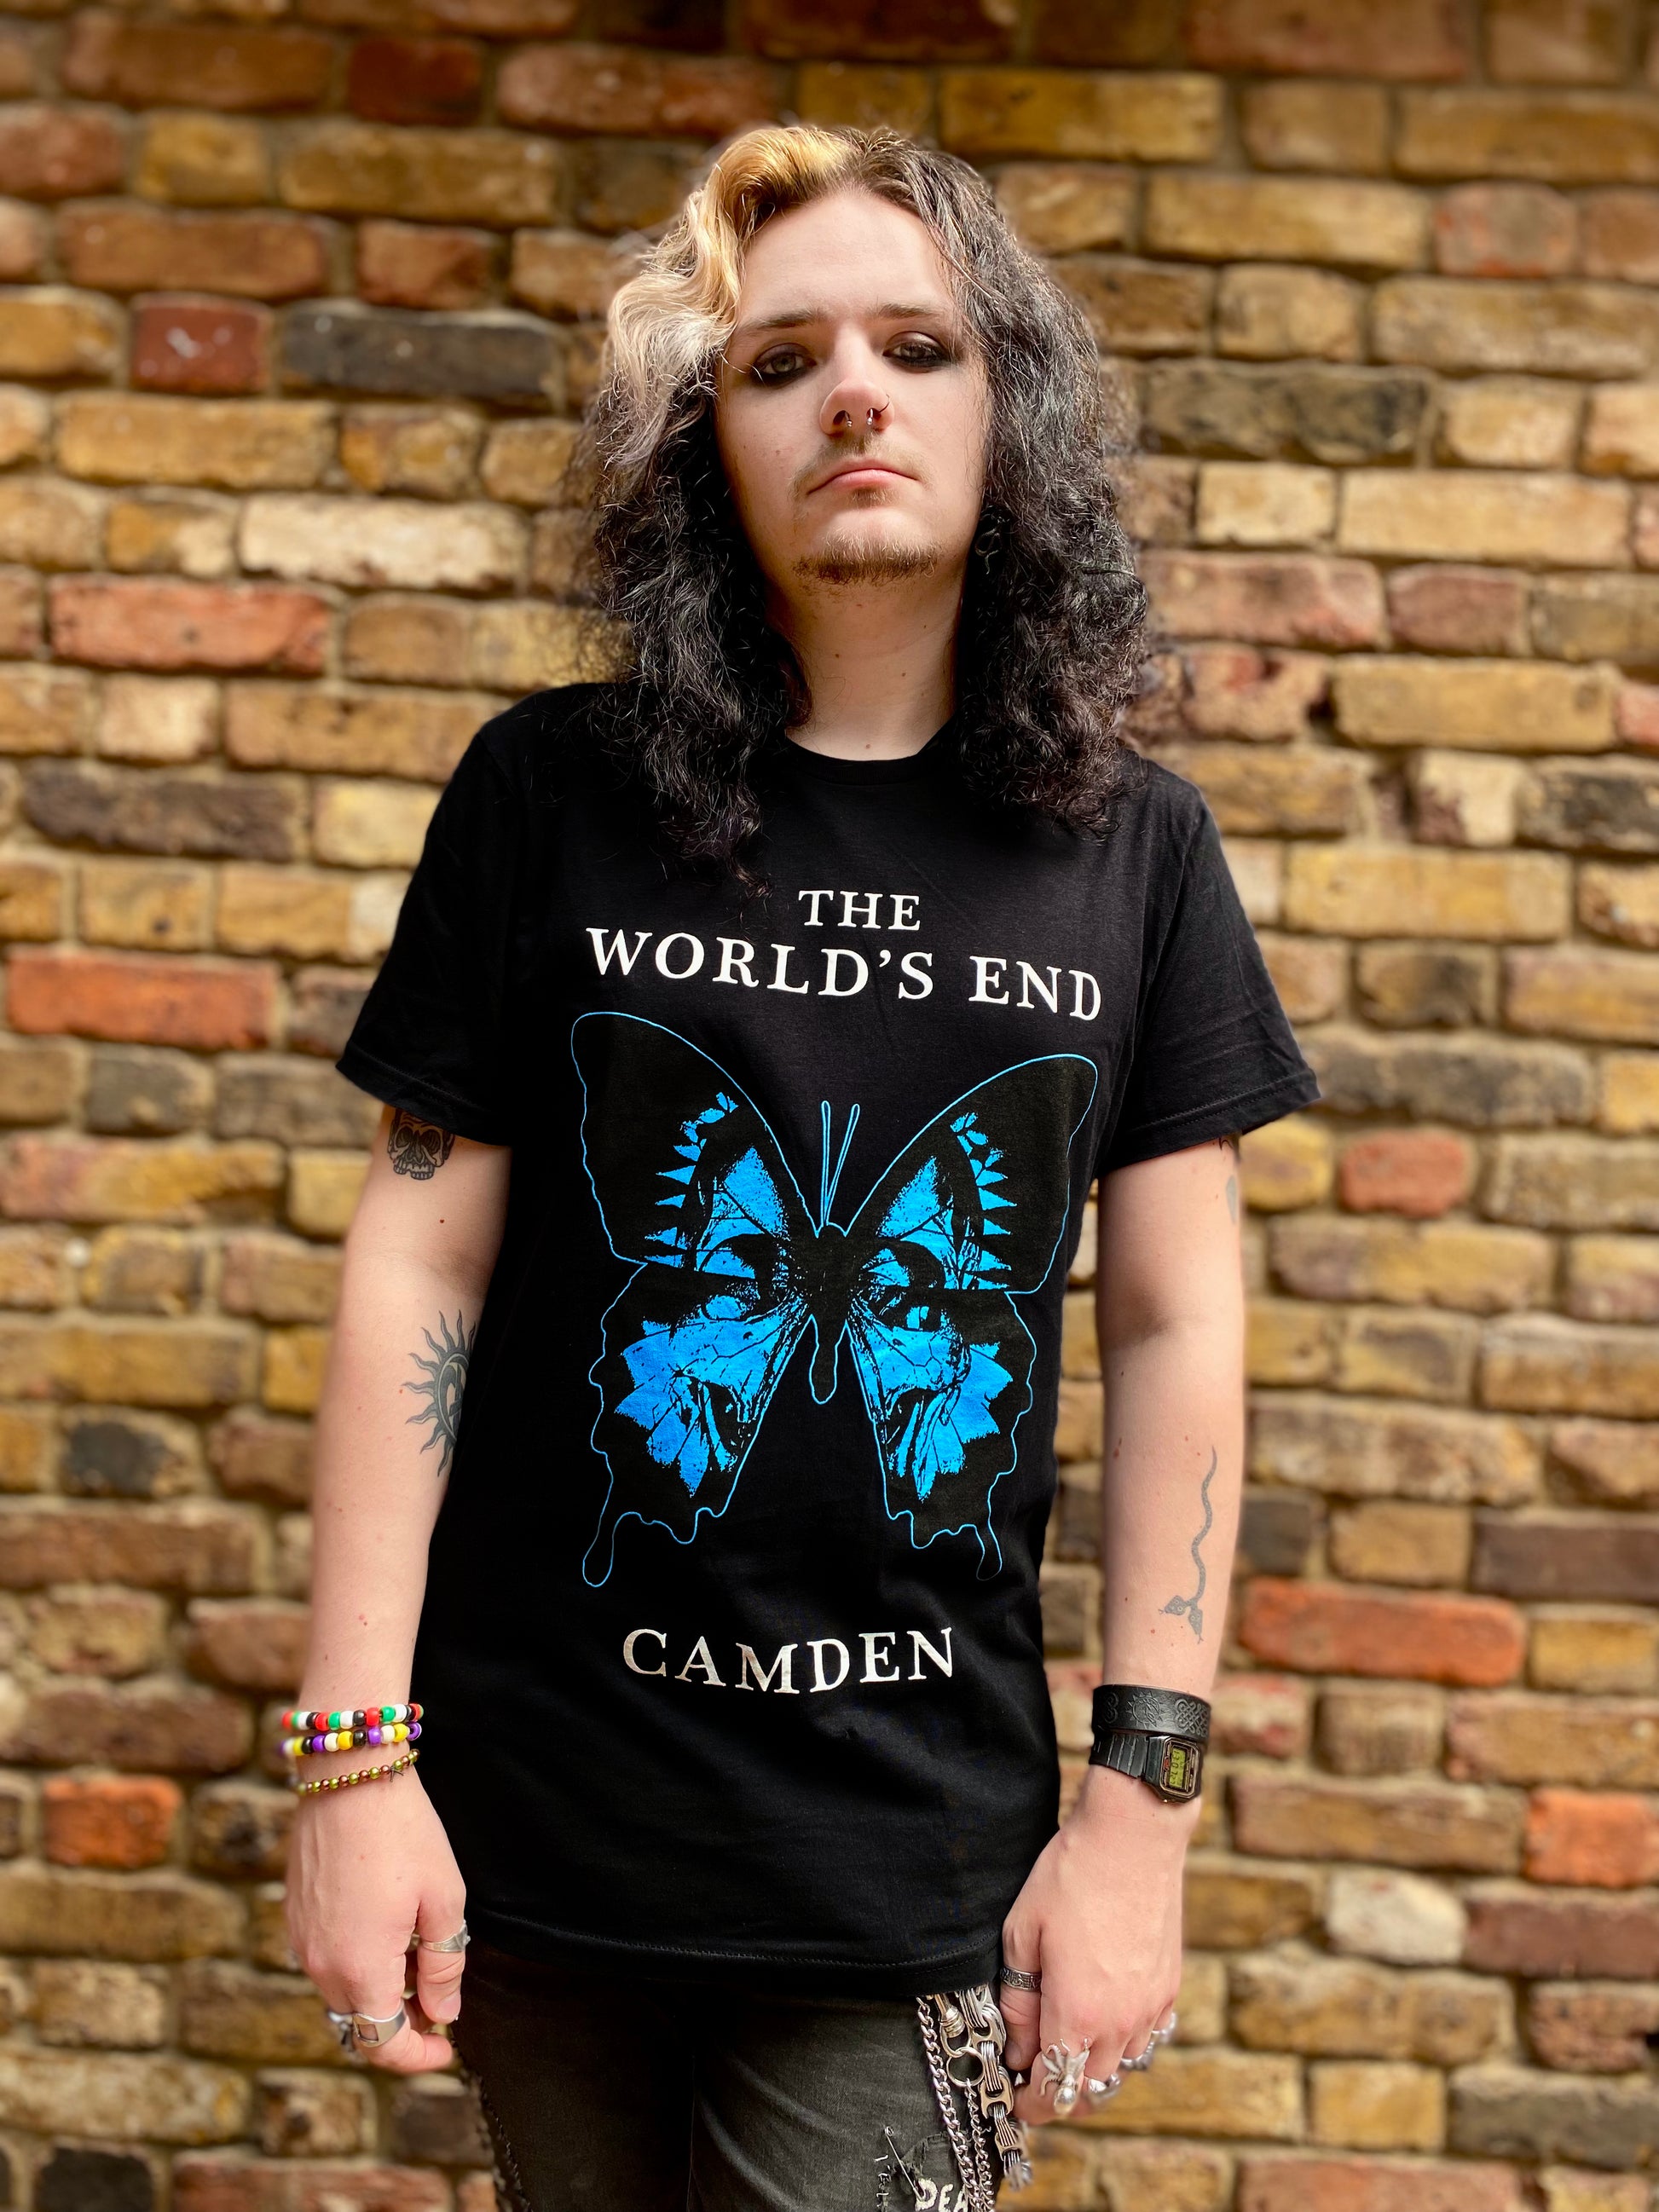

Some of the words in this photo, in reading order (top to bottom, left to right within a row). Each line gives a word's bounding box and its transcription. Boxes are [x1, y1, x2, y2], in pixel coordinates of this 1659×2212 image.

[798, 890, 921, 931] THE
[585, 927, 934, 1000] WORLD'S
[968, 955, 1102, 1021] END
[622, 1626, 953, 1695] CAMDEN
